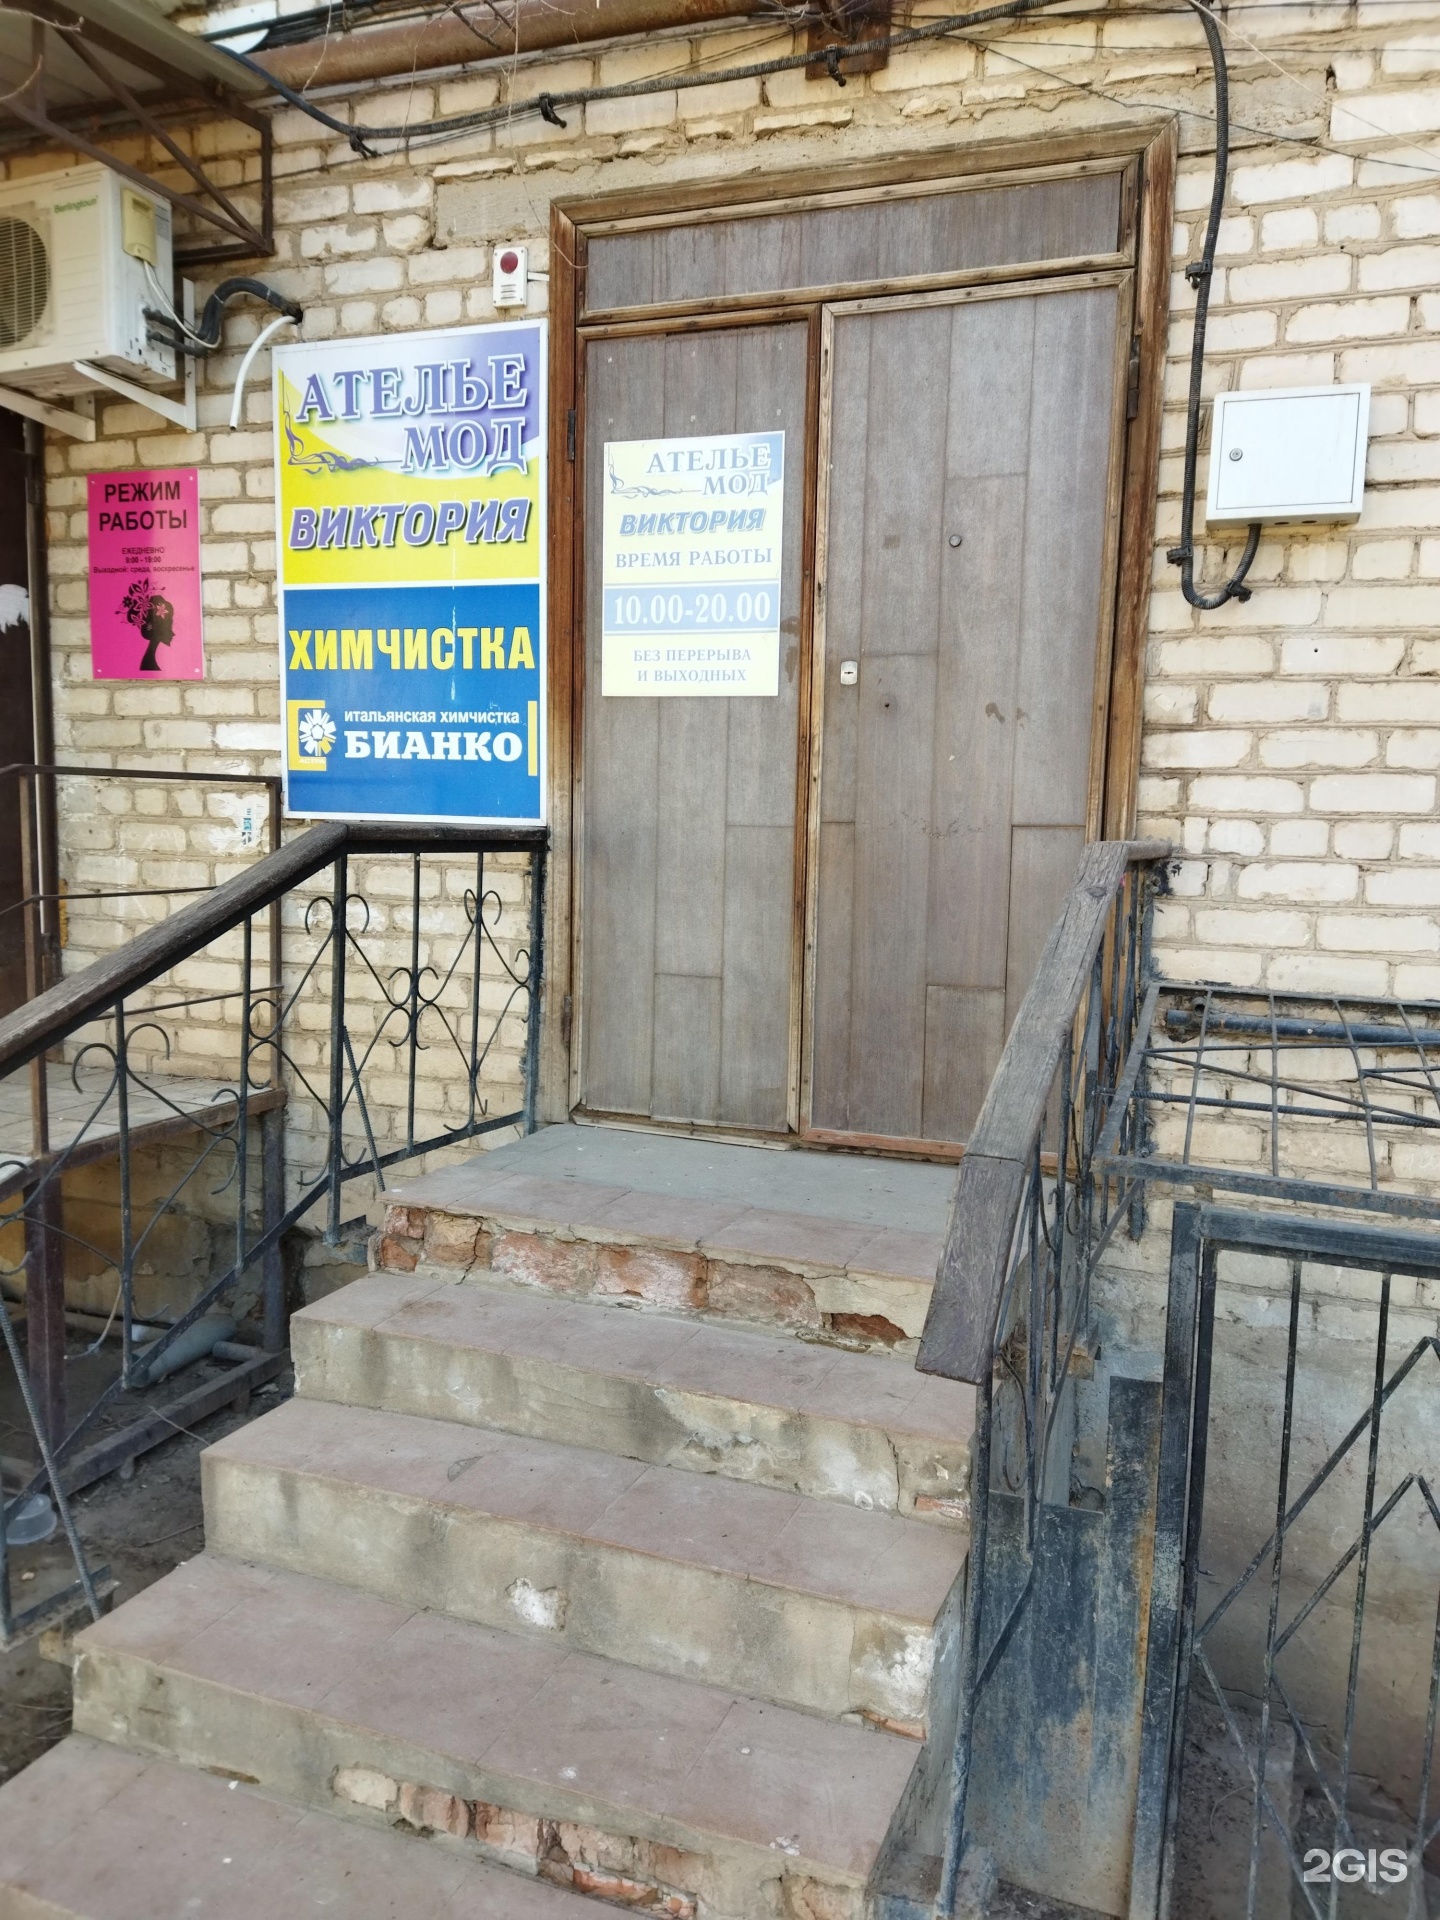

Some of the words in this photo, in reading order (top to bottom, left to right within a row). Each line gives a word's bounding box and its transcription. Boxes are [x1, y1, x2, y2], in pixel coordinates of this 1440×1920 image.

[296, 353, 528, 423] АТЕЛЬЕ
[400, 417, 528, 477] МОД
[647, 444, 772, 474] АТЕЛЬЕ
[105, 481, 180, 503] РЕЖИМ
[702, 471, 769, 498] МОД
[99, 510, 187, 531] РАБОТЫ
[288, 497, 531, 551] ВИКТОРИЯ
[619, 508, 767, 536] ВИКТОРИЯ
[121, 546, 165, 555] ЕЖЕДНЕВНО
[615, 551, 681, 568] ВРЕМЯ
[689, 548, 773, 565] РАБОТЫ
[93, 566, 129, 575] Выходной:
[130, 566, 151, 574] среда,
[153, 565, 196, 573] воскресенье
[613, 591, 772, 625] 10.00-20.00
[287, 626, 536, 671] ХИМЧИСТКА
[633, 650, 661, 662] БЕЗ
[666, 648, 752, 662] ПЕРЕРЫВА
[637, 671, 648, 682] И
[653, 669, 747, 684] ВЫХОДНЫХ
[344, 709, 436, 724] итальянская
[440, 711, 520, 725] химчистка
[343, 730, 523, 763] БИАНКО
